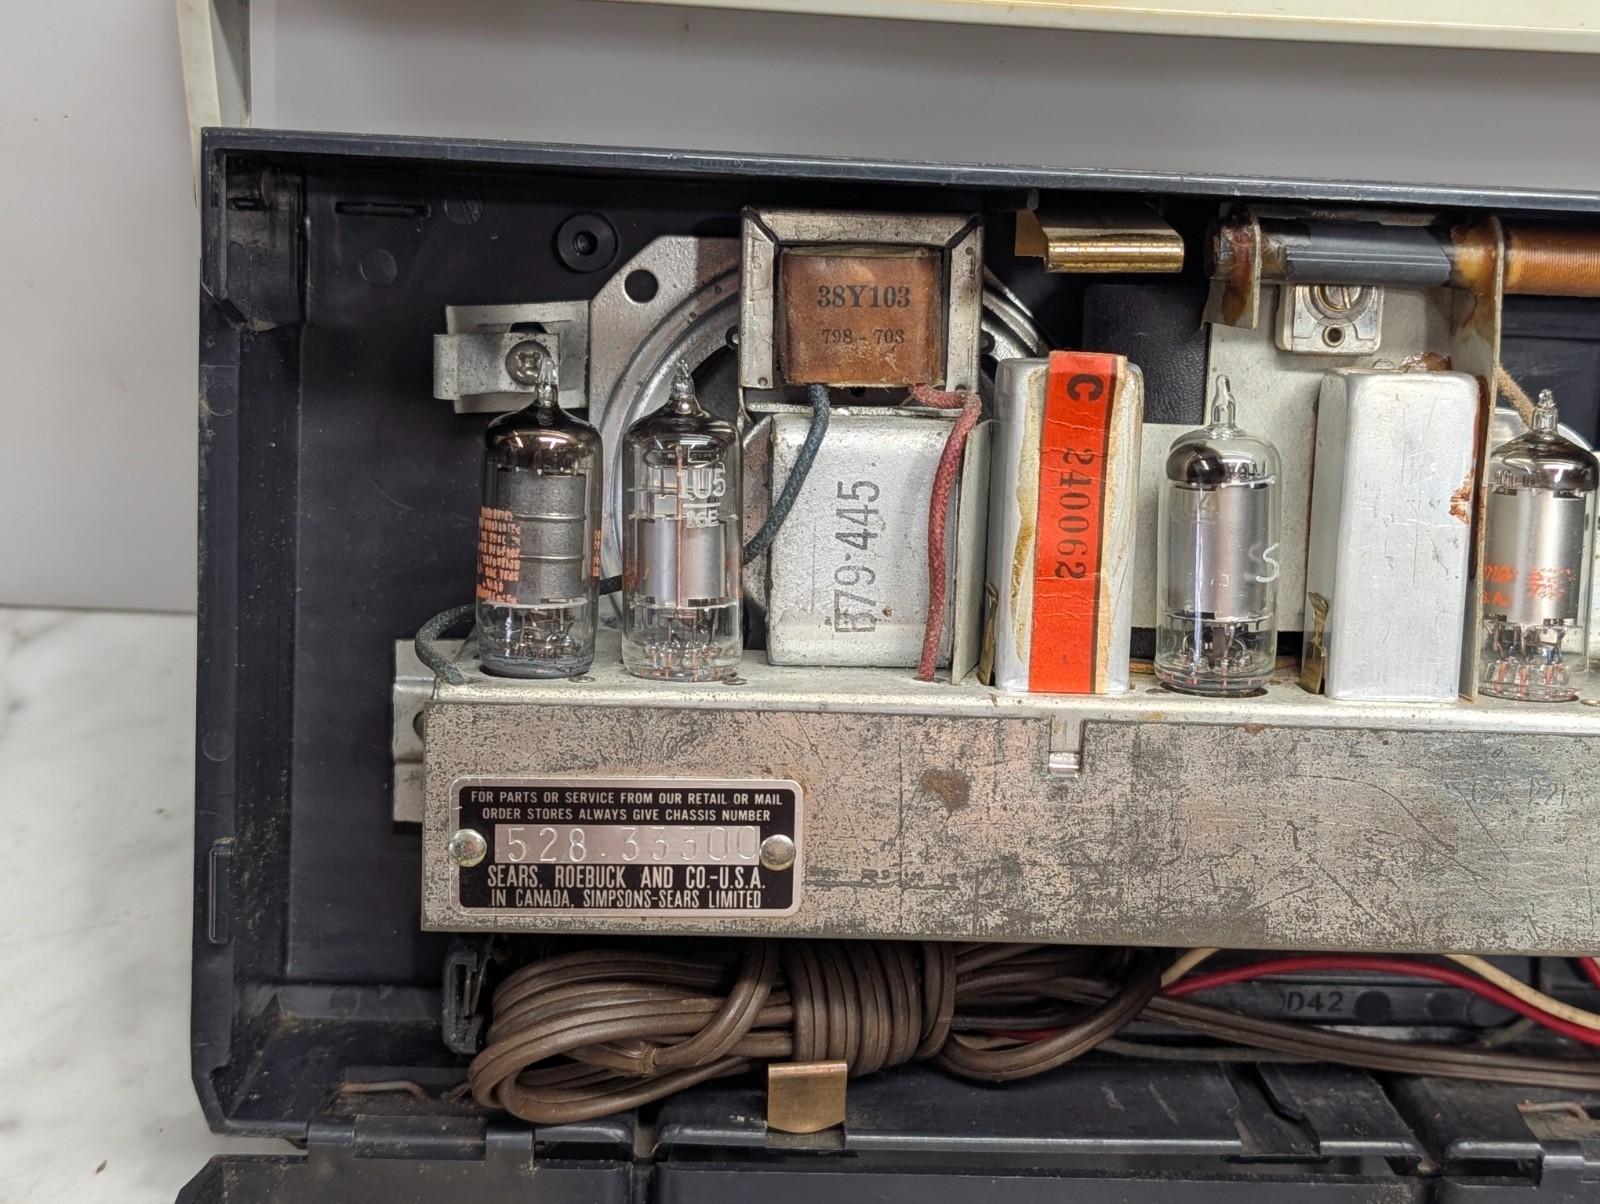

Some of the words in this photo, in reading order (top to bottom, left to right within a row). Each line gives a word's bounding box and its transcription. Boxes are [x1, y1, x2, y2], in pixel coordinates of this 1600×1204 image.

[817, 285, 910, 308] 38Y103
[821, 328, 853, 344] 798
[873, 328, 905, 344] 703
[1066, 374, 1104, 402] C
[1053, 446, 1096, 581] 240062
[471, 790, 494, 802] FOR
[500, 791, 538, 803] PARTS
[543, 791, 559, 803] OR
[565, 792, 614, 804] SERVICE
[620, 792, 653, 805] FROM
[658, 792, 683, 805] OUR
[687, 793, 728, 805] RETAIL
[733, 793, 749, 805] OR
[754, 793, 783, 806] MAIL
[482, 808, 521, 820] ORDER
[527, 808, 573, 820] STORES
[578, 808, 627, 821] ALWAYS
[632, 808, 660, 821] GIVE
[665, 809, 717, 821] CHASSIS
[721, 809, 771, 822] NUMBER
[554, 865, 627, 889] ROEBUCK
[640, 866, 674, 889] AND
[491, 889, 507, 907] IN
[515, 889, 575, 909] CANADA,
[583, 889, 700, 908] SIMPSONS-SEARS
[708, 890, 762, 909] LIMITED
[1286, 991, 1344, 1013] D42
